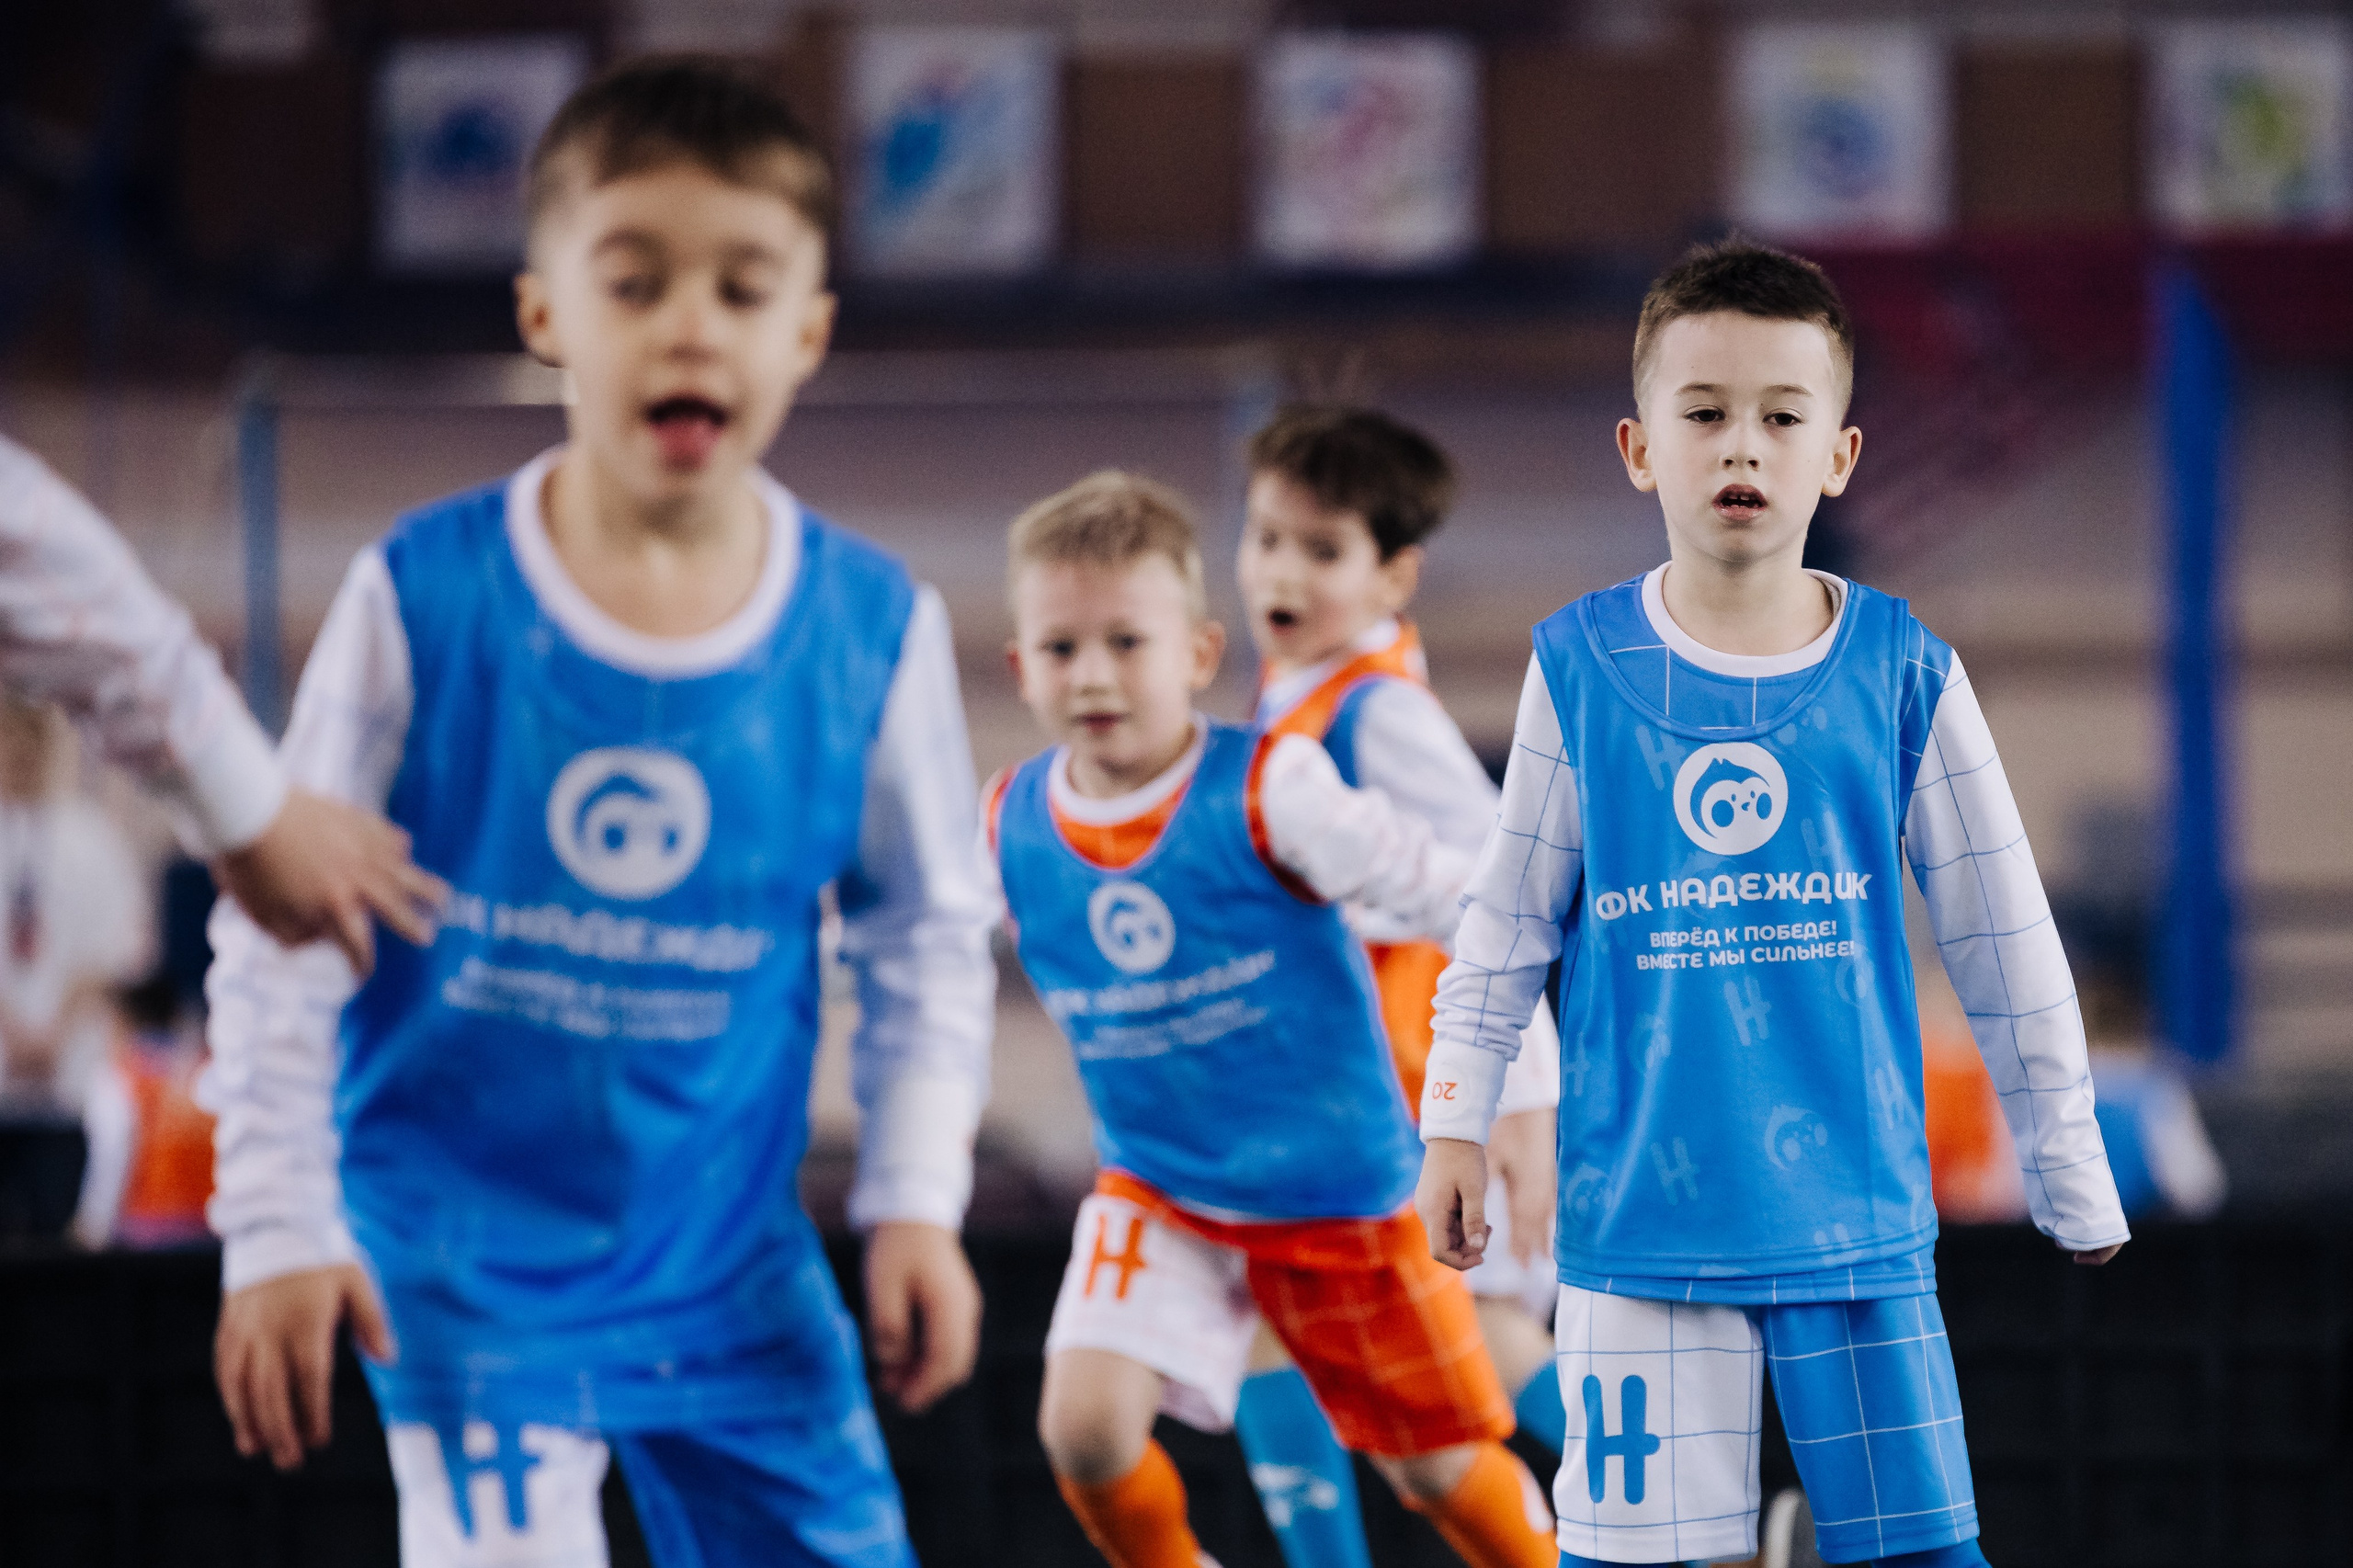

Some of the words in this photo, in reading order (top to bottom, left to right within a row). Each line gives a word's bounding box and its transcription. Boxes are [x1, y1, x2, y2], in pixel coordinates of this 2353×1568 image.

[1596, 883, 1654, 921] ФК
[1660, 871, 1873, 909] НАДЕЖДИК
[1650, 927, 1721, 949] ВПЕРЁД
[1725, 926, 1739, 944] К
[1745, 920, 1837, 942] ПОБЕДЕ!
[1636, 952, 1704, 971] ВМЕСТЕ
[1710, 948, 1745, 967] МЫ
[1751, 939, 1855, 962] СИЛЬНЕЕ!
[1432, 1081, 1459, 1101] 20
